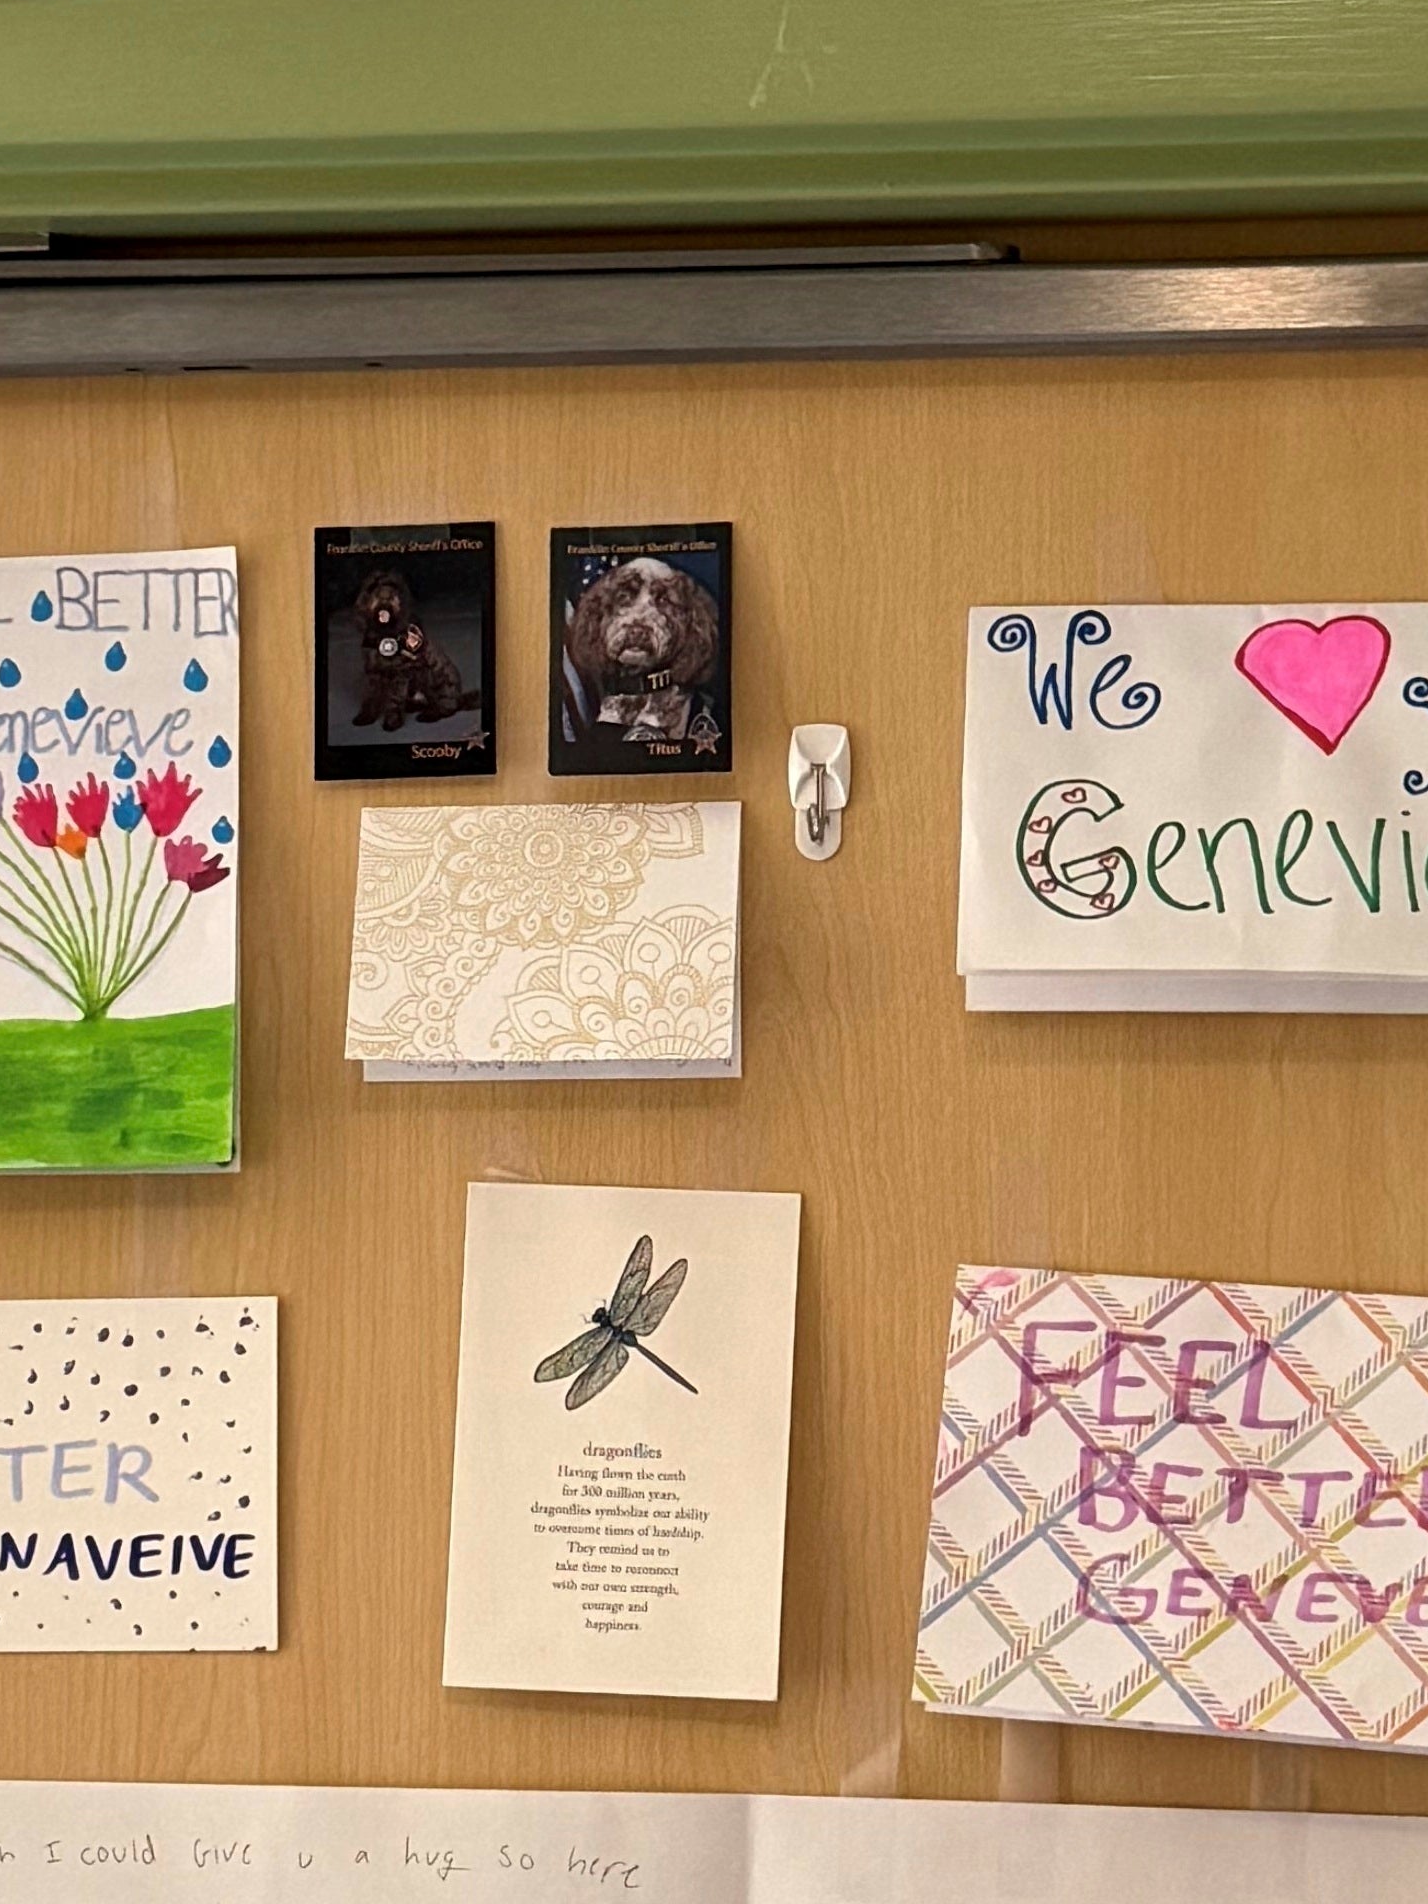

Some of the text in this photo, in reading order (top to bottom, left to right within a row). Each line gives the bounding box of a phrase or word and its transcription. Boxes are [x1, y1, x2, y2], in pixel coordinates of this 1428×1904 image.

[55, 568, 240, 637] BETTER
[987, 610, 1162, 730] We
[1017, 1321, 1297, 1437] FEEL
[583, 1441, 662, 1461] dragonflies
[557, 1465, 654, 1481] Having the
[563, 1484, 645, 1499] for 300 million
[675, 1507, 710, 1523] ability
[638, 1526, 650, 1536] of
[567, 1541, 596, 1556] They
[556, 1560, 578, 1571] take
[582, 1562, 607, 1572] time
[552, 1581, 577, 1590] with
[628, 1602, 648, 1612] and
[44, 1839, 63, 1864] I
[81, 1838, 158, 1866] could
[402, 1836, 472, 1874] hug
